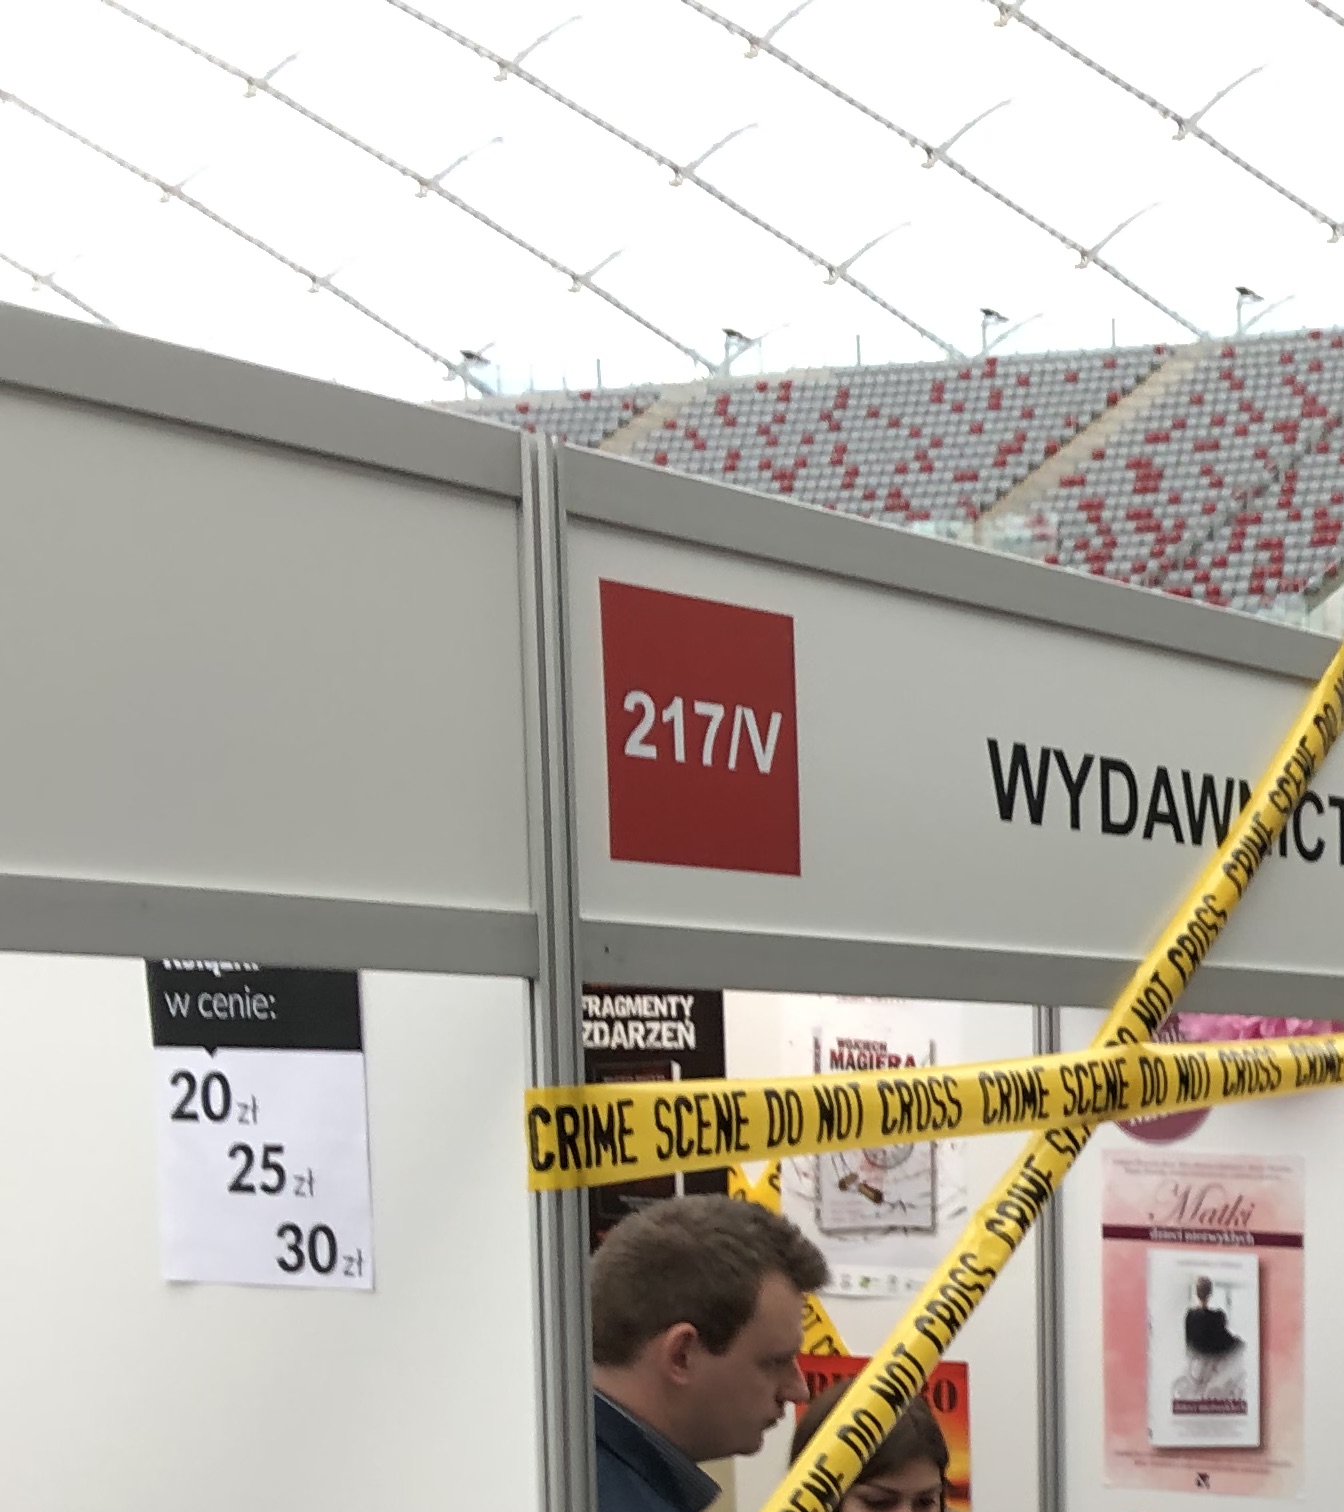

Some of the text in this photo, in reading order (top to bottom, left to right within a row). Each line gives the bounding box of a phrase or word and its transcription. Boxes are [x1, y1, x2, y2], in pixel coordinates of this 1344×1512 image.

[623, 690, 782, 774] 217/V
[1131, 970, 1175, 1033] NOT
[1166, 893, 1229, 981] CROSS
[1222, 811, 1275, 901] CRIME
[1268, 735, 1317, 816] SCENE
[164, 984, 277, 1020] w cenie:
[830, 1048, 916, 1072] MAGIERA
[169, 1069, 259, 1125] 20 zł
[527, 1098, 638, 1172] CRIME
[654, 1090, 751, 1161] SCENE
[763, 1087, 804, 1149] DO
[813, 1081, 865, 1144] NOT
[877, 1073, 963, 1136] CROSS
[977, 1065, 1051, 1125] CRIME
[1059, 1057, 1130, 1118] SCENE
[1139, 1054, 1169, 1109] DO
[1173, 1051, 1212, 1104] NOT
[1218, 1045, 1282, 1098] CROSS
[227, 1143, 316, 1198] 25 zł
[1149, 1180, 1255, 1228] Matki
[275, 1222, 364, 1278] 30 zł
[837, 1408, 884, 1464] DO
[870, 1342, 926, 1417] NOT
[914, 1252, 997, 1354] CROSS
[984, 1153, 1054, 1251] CRIME
